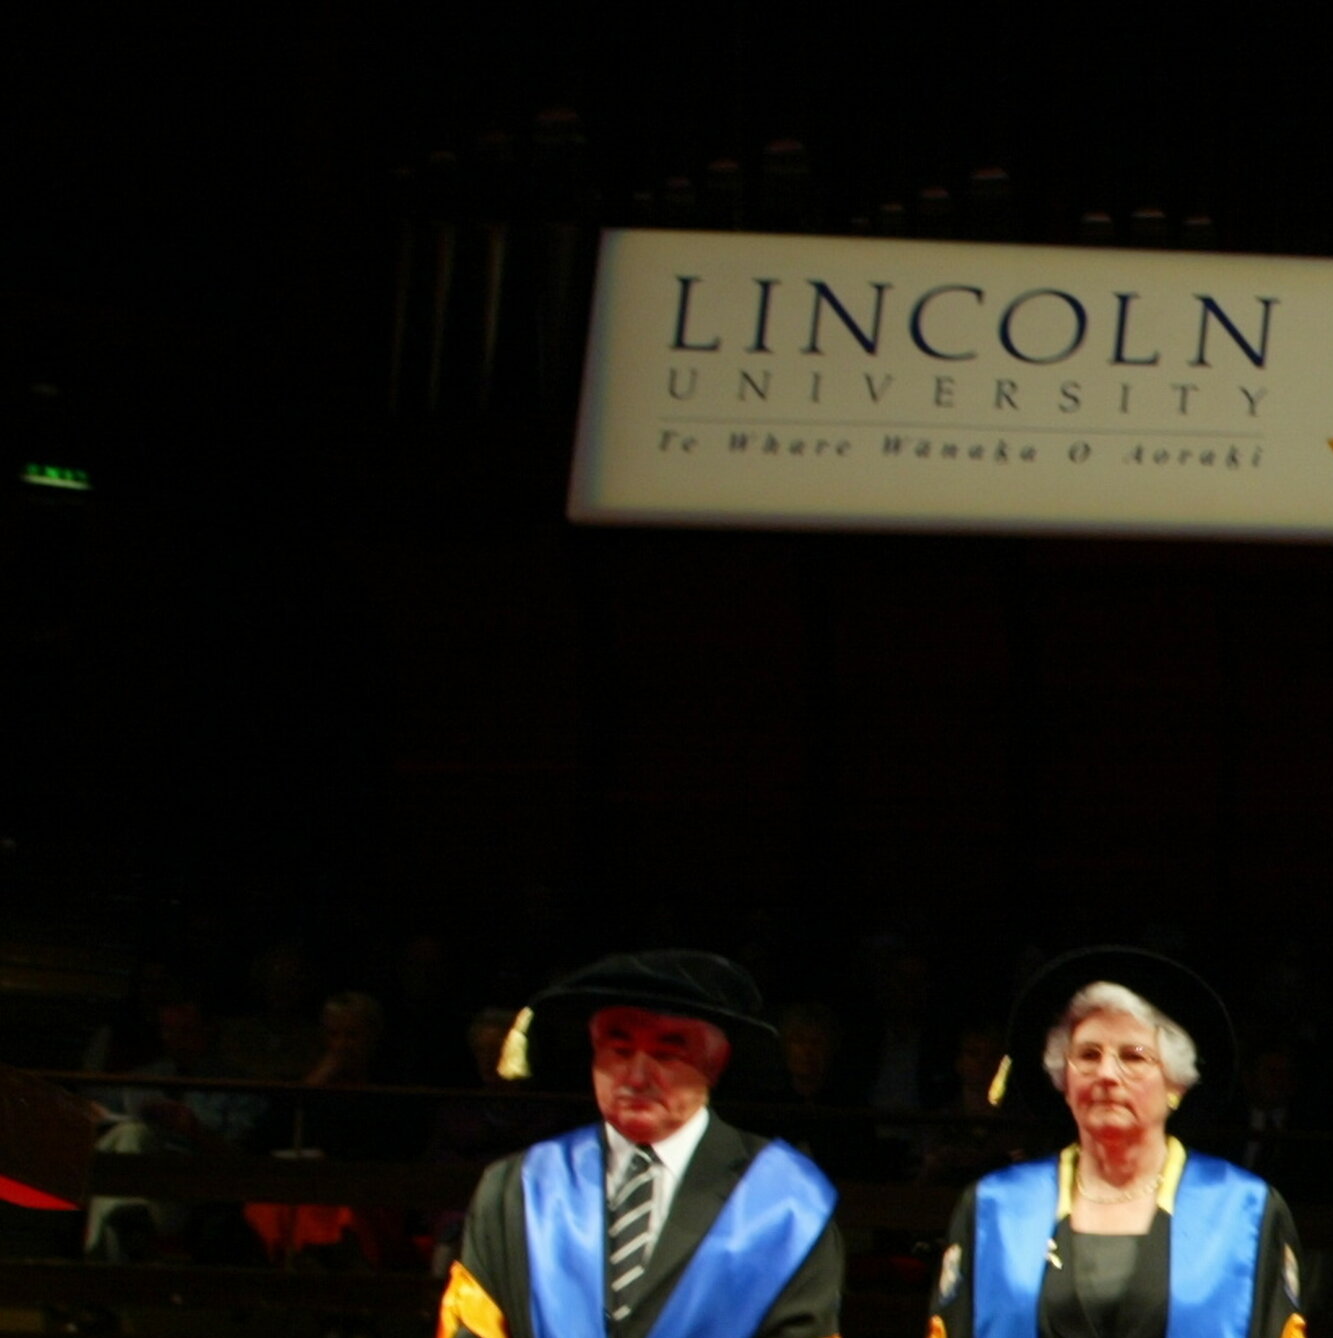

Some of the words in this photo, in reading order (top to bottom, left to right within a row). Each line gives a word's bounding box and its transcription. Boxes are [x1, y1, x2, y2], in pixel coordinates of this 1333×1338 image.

[668, 273, 1281, 370] LINCOLN
[666, 368, 1266, 417] UNIVERSITY
[657, 429, 697, 453] Te
[727, 430, 851, 457] Whare
[1121, 443, 1263, 469] Aoraki
